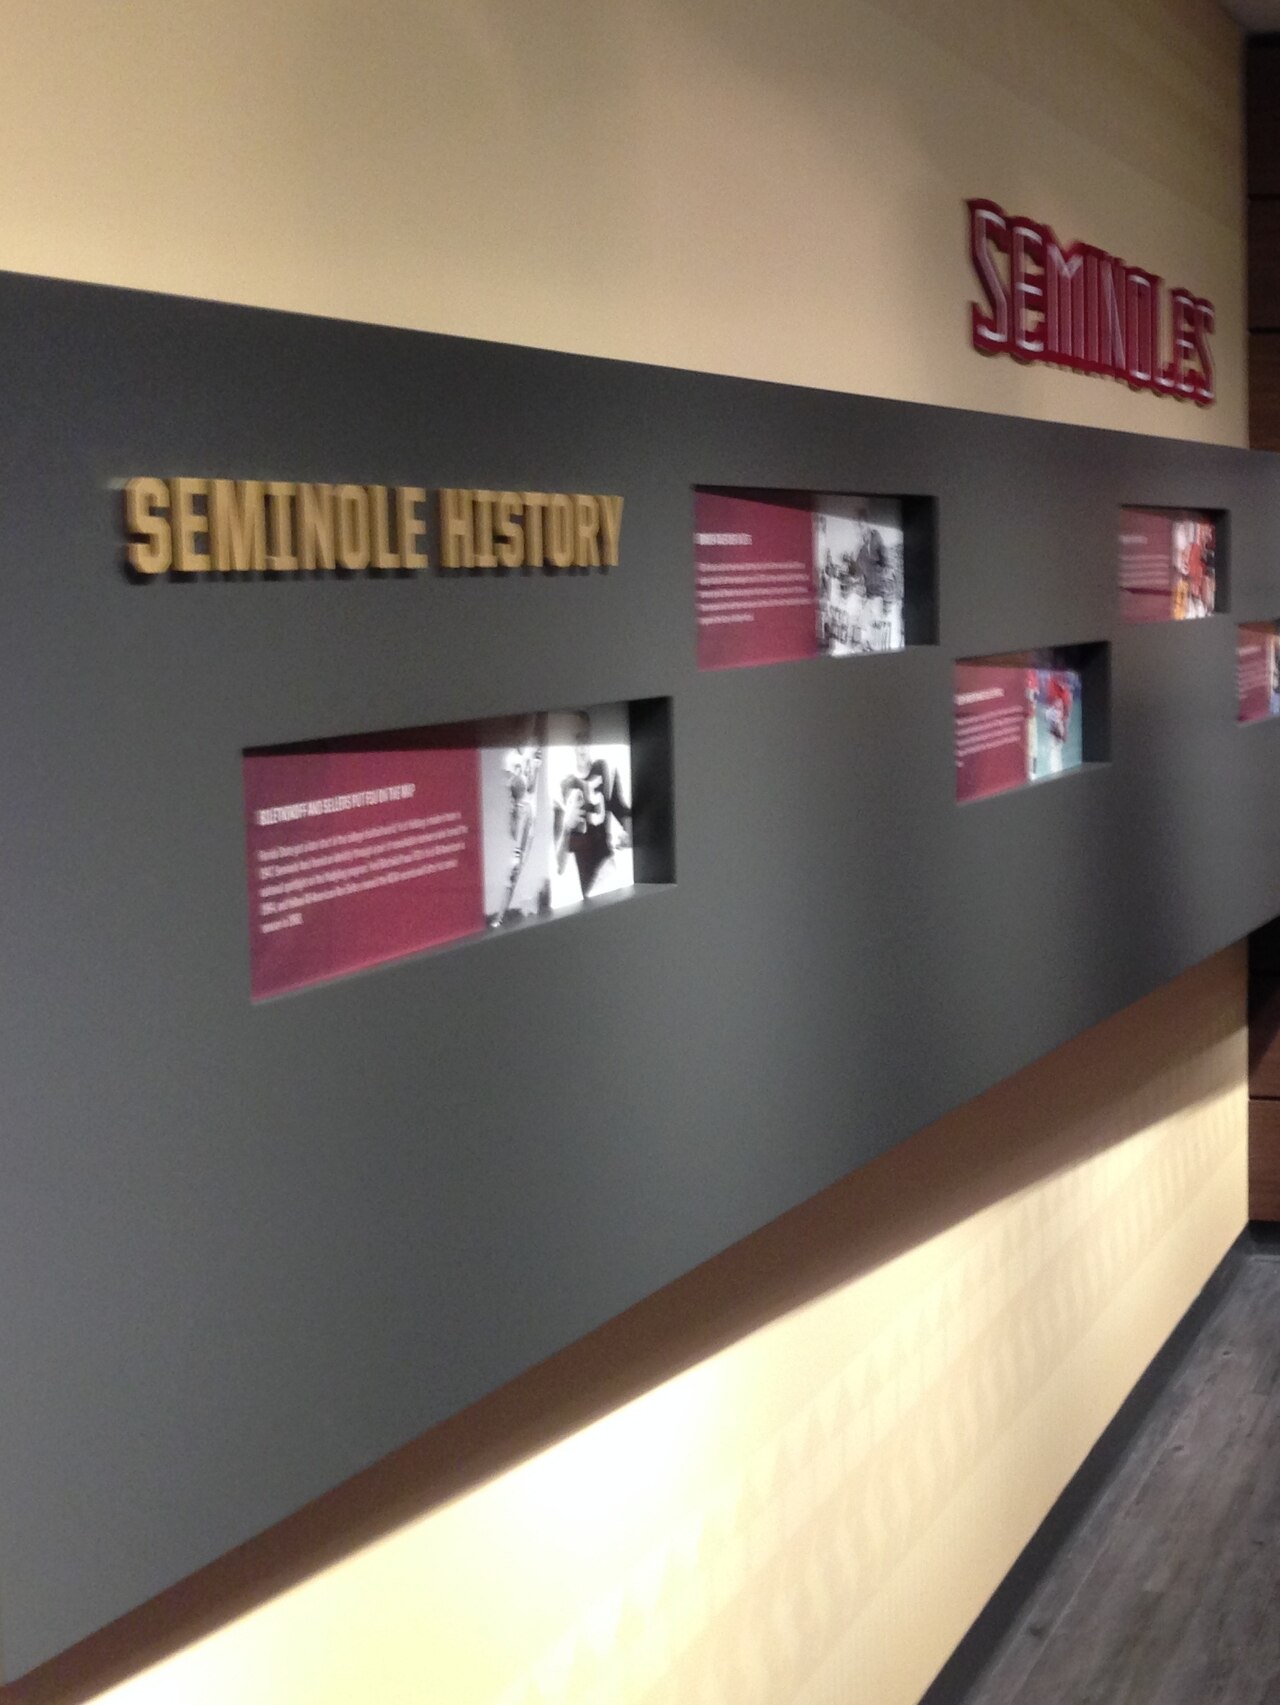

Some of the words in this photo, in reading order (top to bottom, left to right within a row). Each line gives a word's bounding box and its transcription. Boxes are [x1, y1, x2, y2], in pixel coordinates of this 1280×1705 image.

[964, 198, 1215, 405] SEMINOLES
[123, 476, 429, 575] SEMINOLE
[439, 487, 625, 569] HISTORY
